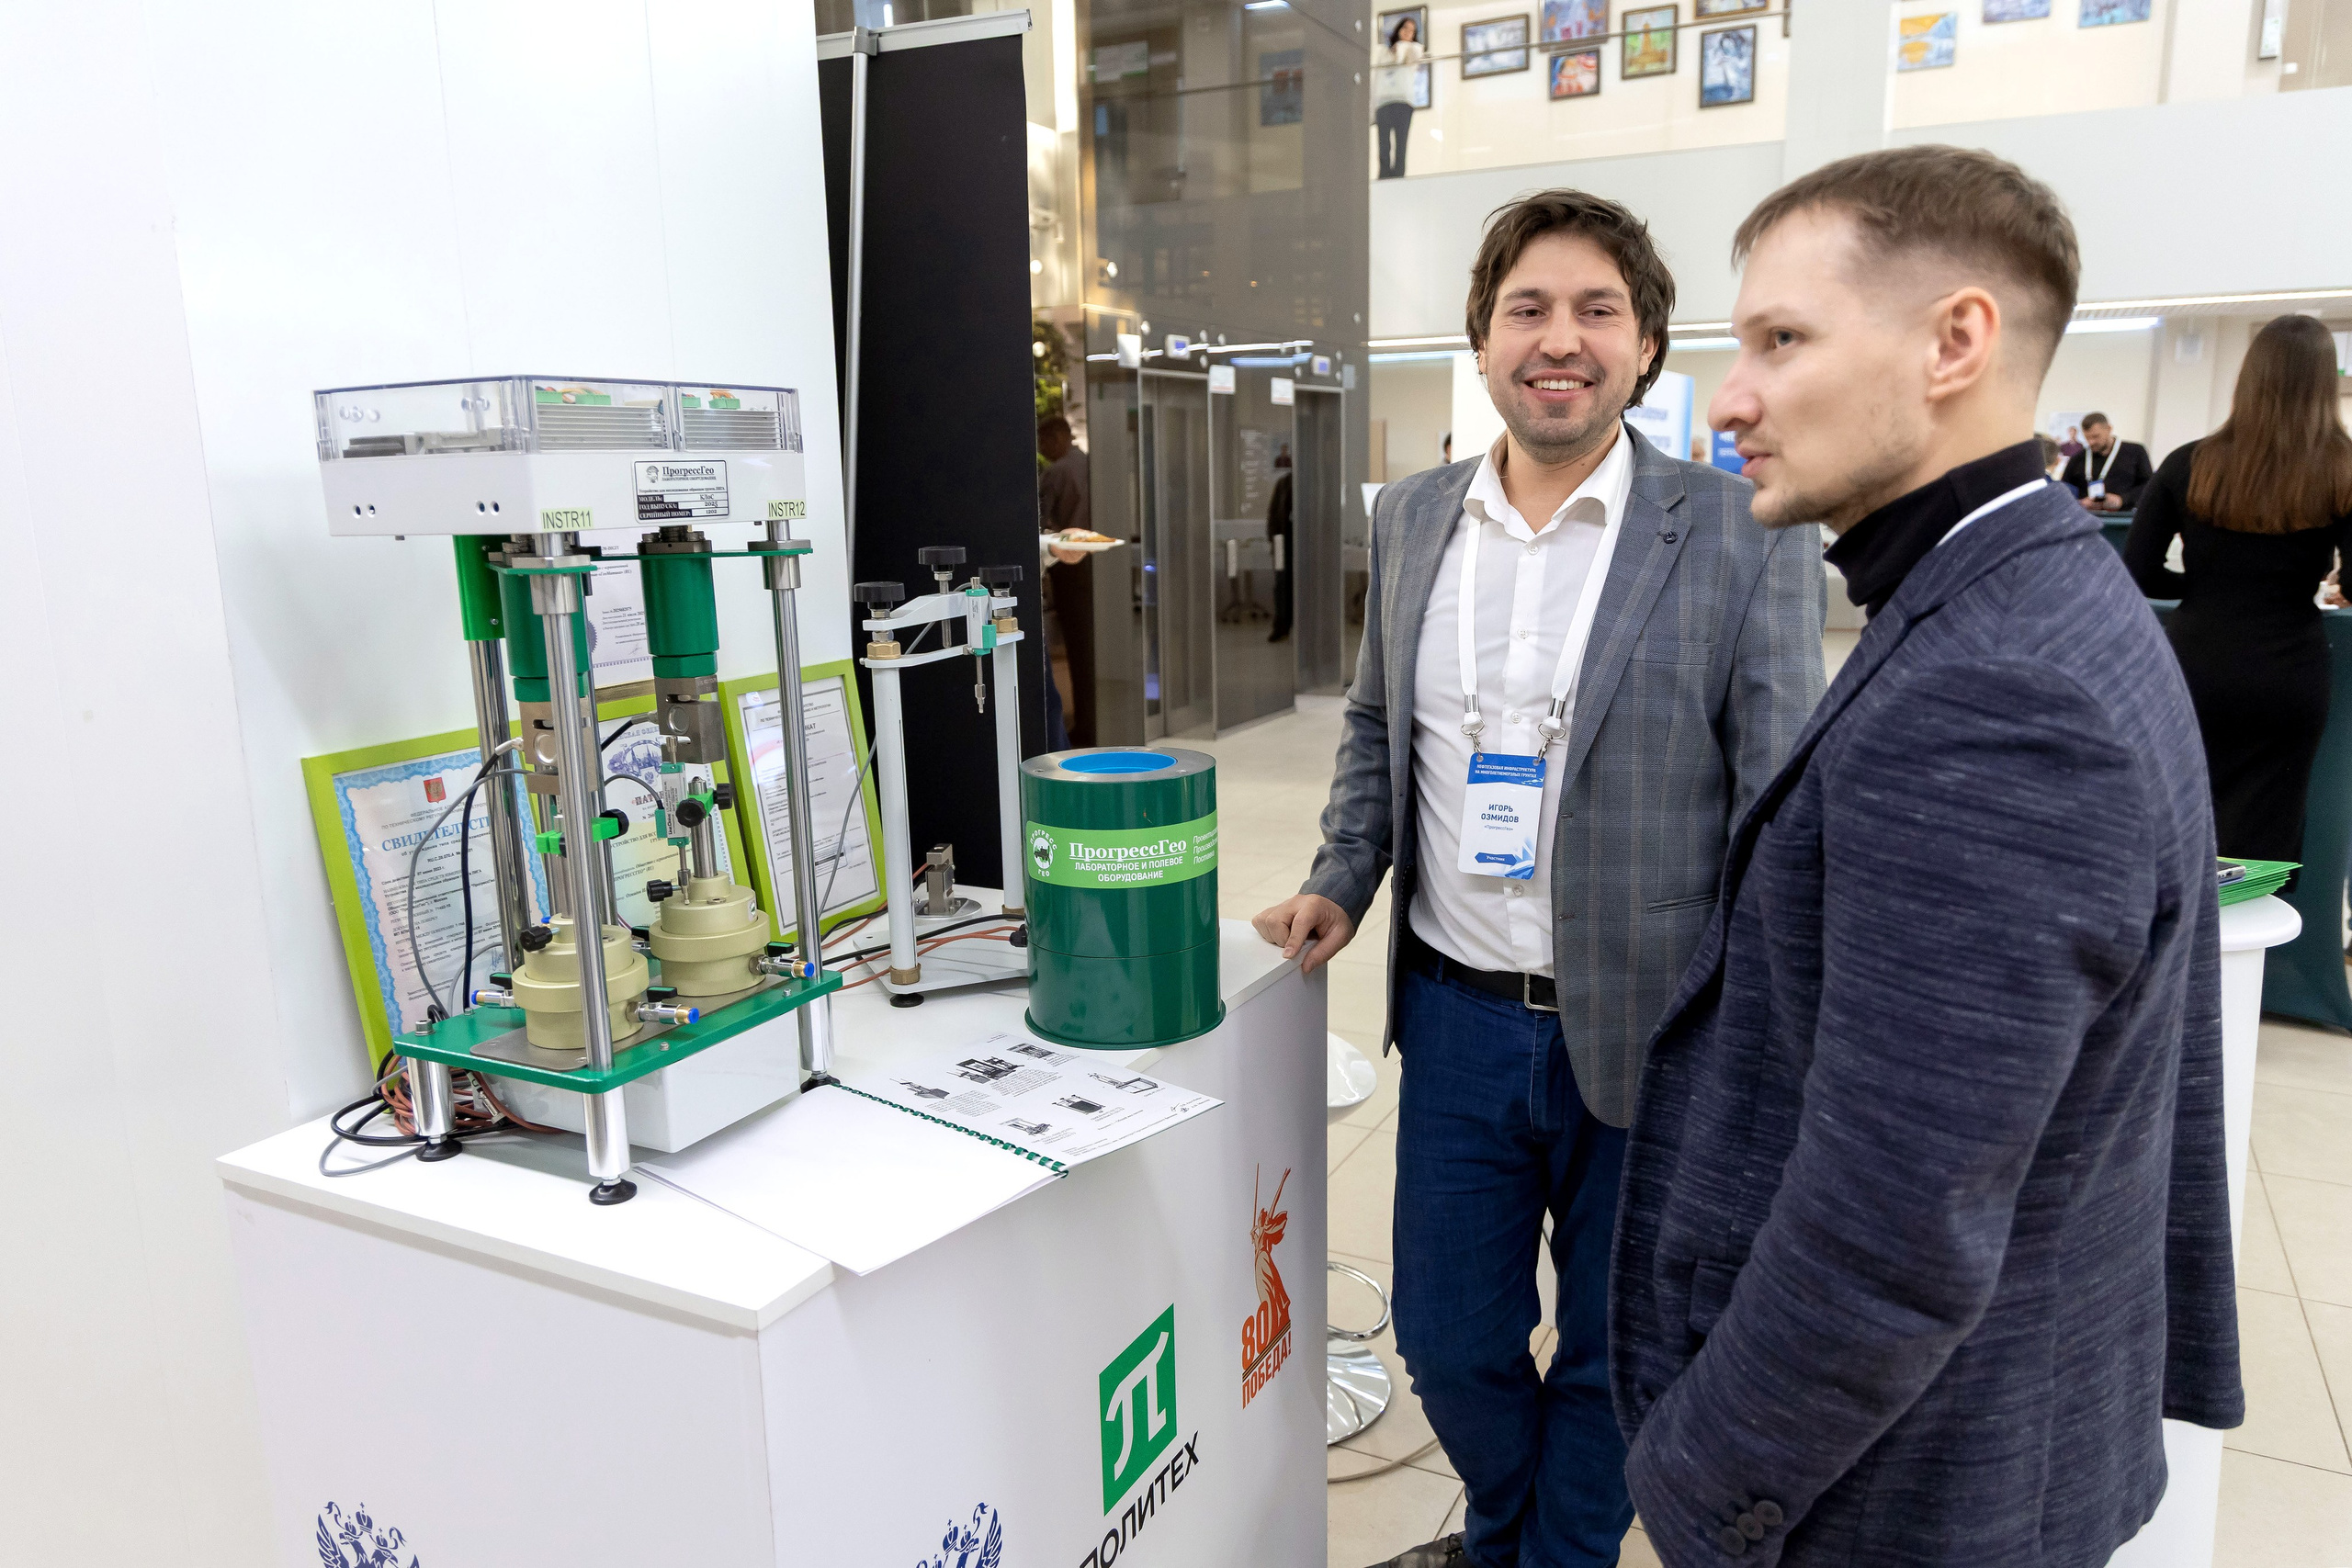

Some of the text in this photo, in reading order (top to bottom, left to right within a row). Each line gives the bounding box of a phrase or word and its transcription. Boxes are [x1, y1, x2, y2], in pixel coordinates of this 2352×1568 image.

[662, 466, 715, 477] ПрогрессГео
[768, 501, 806, 518] INSTR12
[542, 510, 592, 529] INSTR11
[1488, 803, 1514, 813] ИГОРЬ
[1480, 813, 1520, 823] ОЗМИДОВ
[381, 817, 490, 852] СВИДТЕЛСТ
[1029, 829, 1057, 851] ПРОГРЕСС
[1069, 839, 1187, 863] ПрогрессГео
[1074, 856, 1183, 872] ЛАБОРАТОРНОЕ И ПОЛЕВОЕ
[1037, 869, 1050, 877] ГЕО
[1097, 870, 1164, 883] ОБОРУДОВАНИЕ
[1242, 1331, 1292, 1410] ПОБЕДА!
